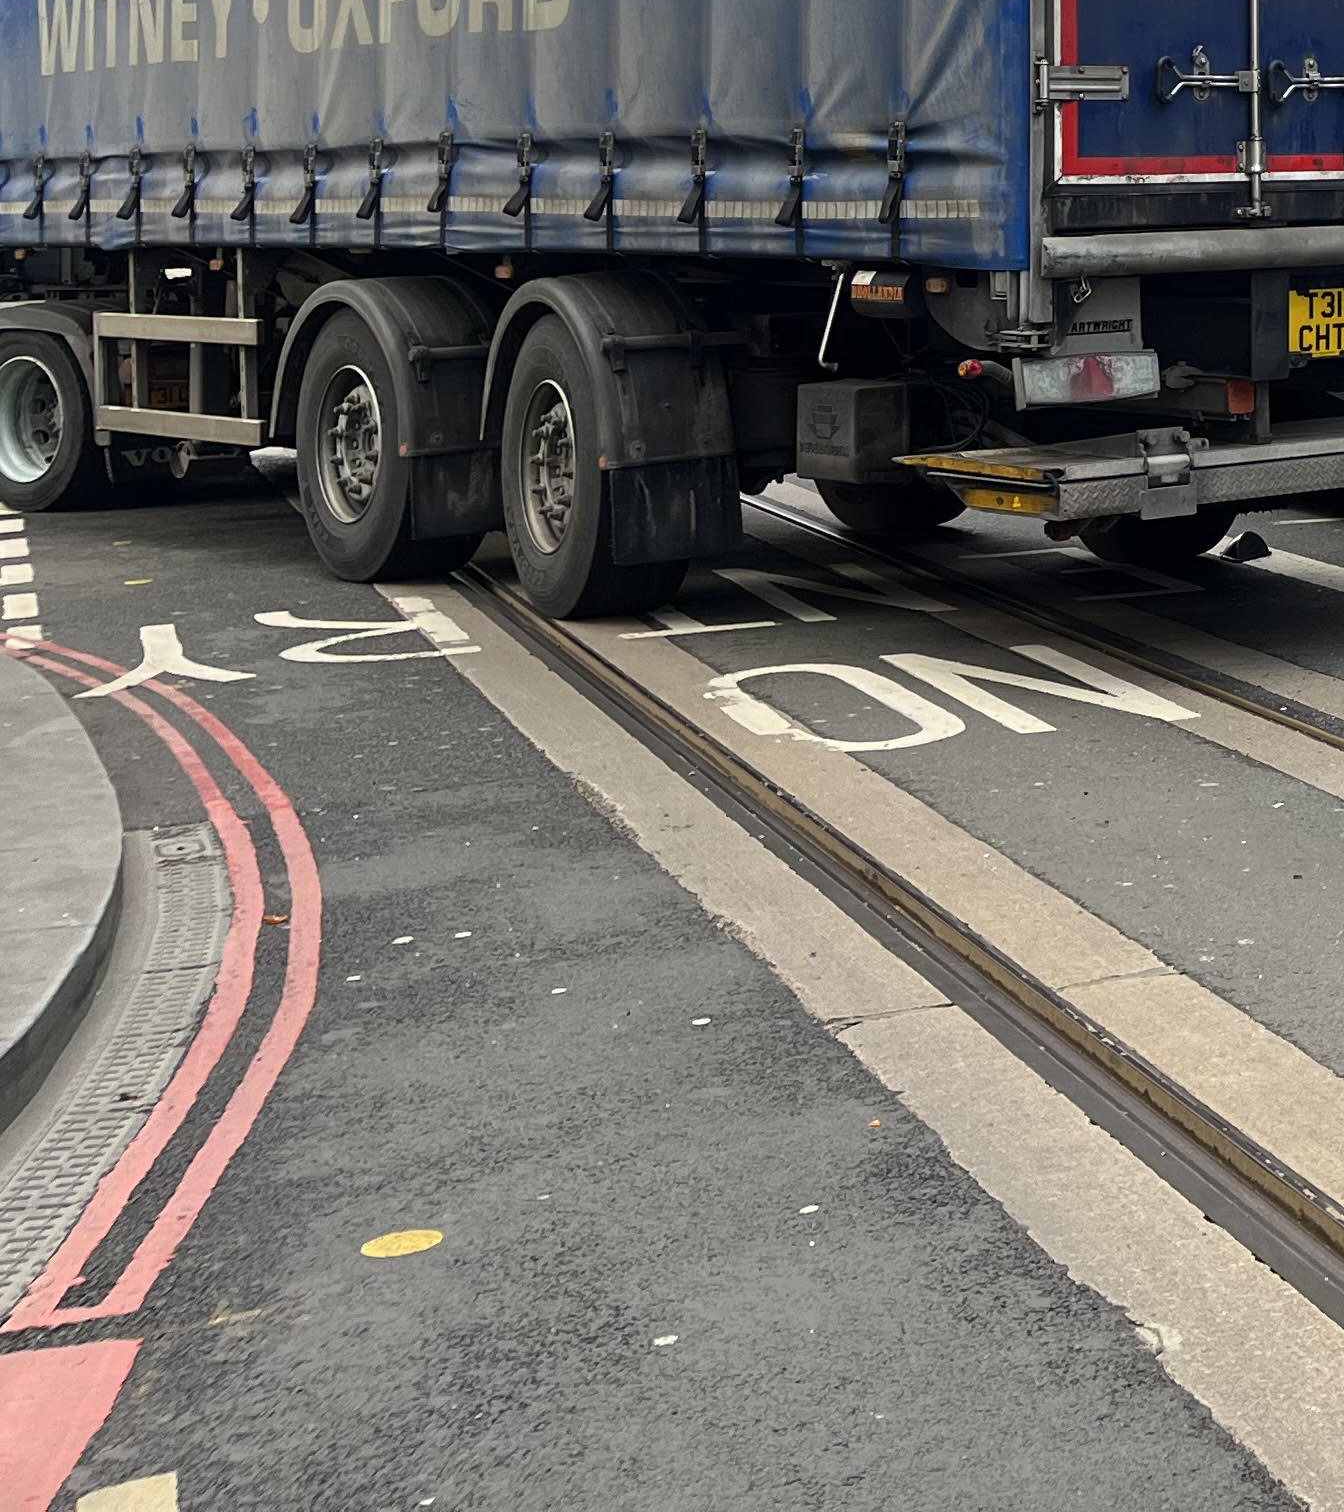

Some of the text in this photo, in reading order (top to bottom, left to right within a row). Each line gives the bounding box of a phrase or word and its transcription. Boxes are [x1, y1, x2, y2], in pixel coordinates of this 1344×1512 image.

[1304, 291, 1342, 319] T31
[1071, 319, 1133, 333] ARTWRIGHT
[704, 644, 1202, 751] NO
